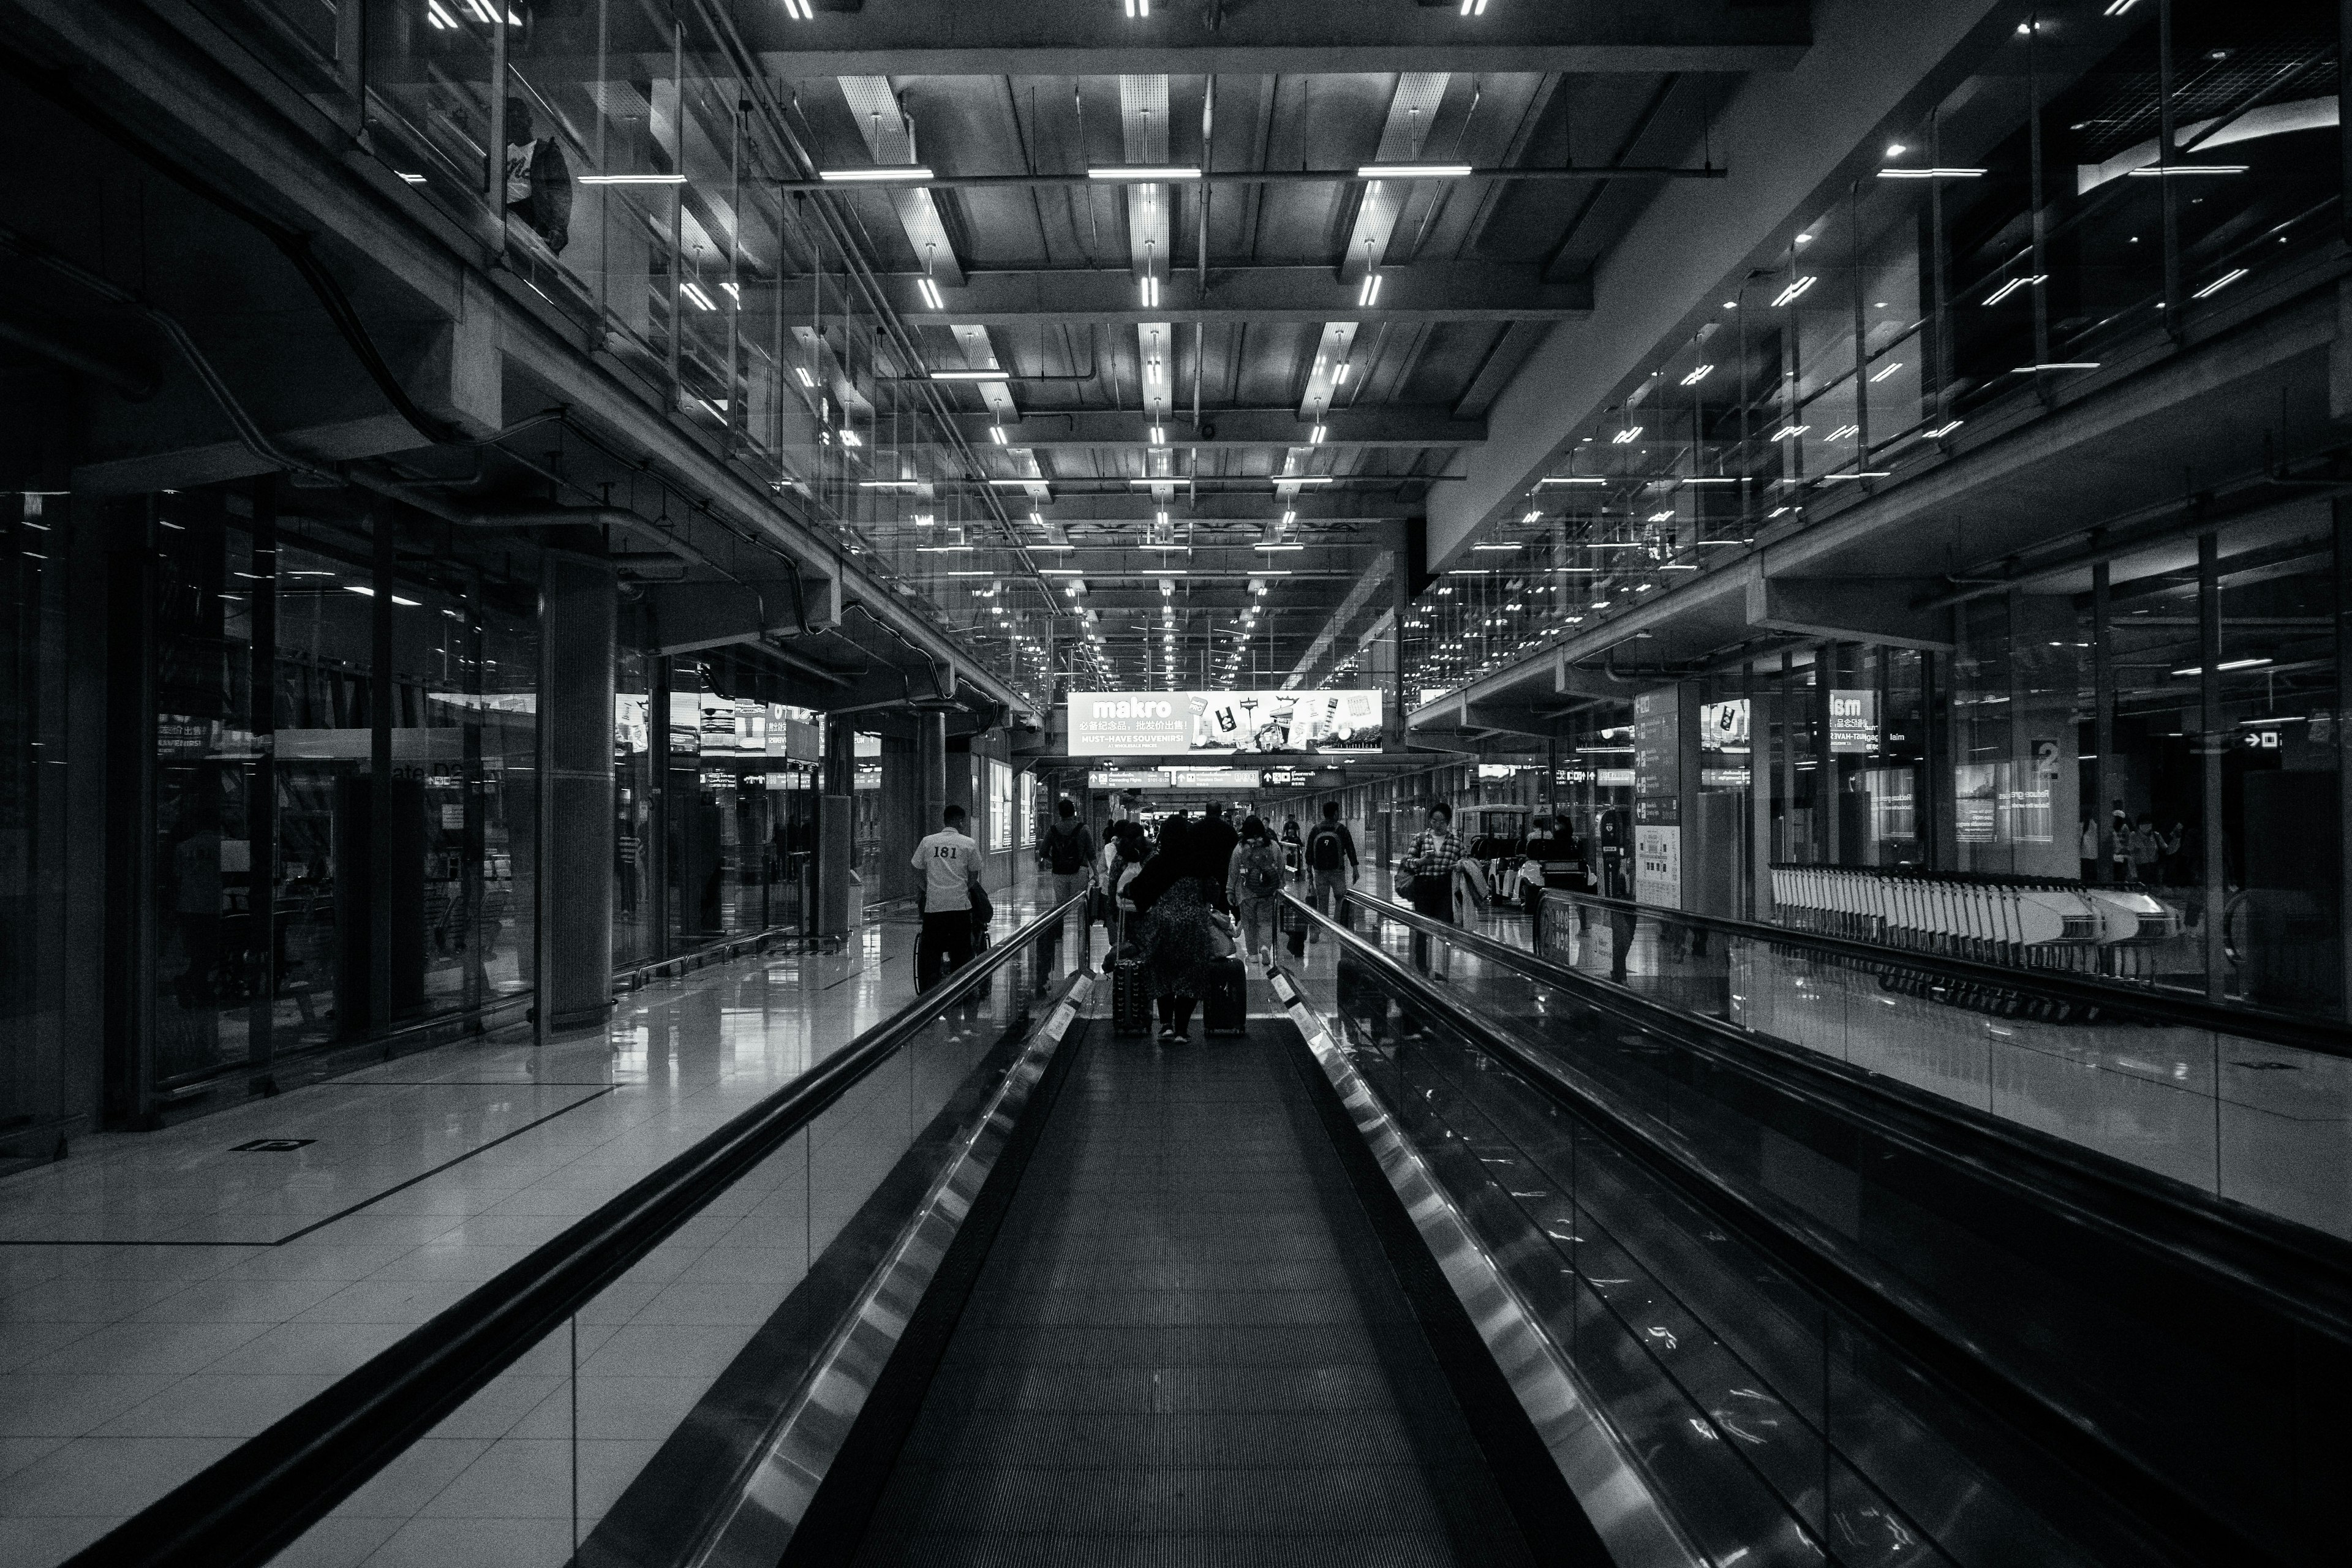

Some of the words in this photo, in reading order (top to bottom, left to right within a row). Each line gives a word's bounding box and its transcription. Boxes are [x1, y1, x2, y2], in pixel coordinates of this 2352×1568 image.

[1092, 696, 1172, 718] makro
[2039, 742, 2059, 772] 2
[933, 846, 957, 859] 181
